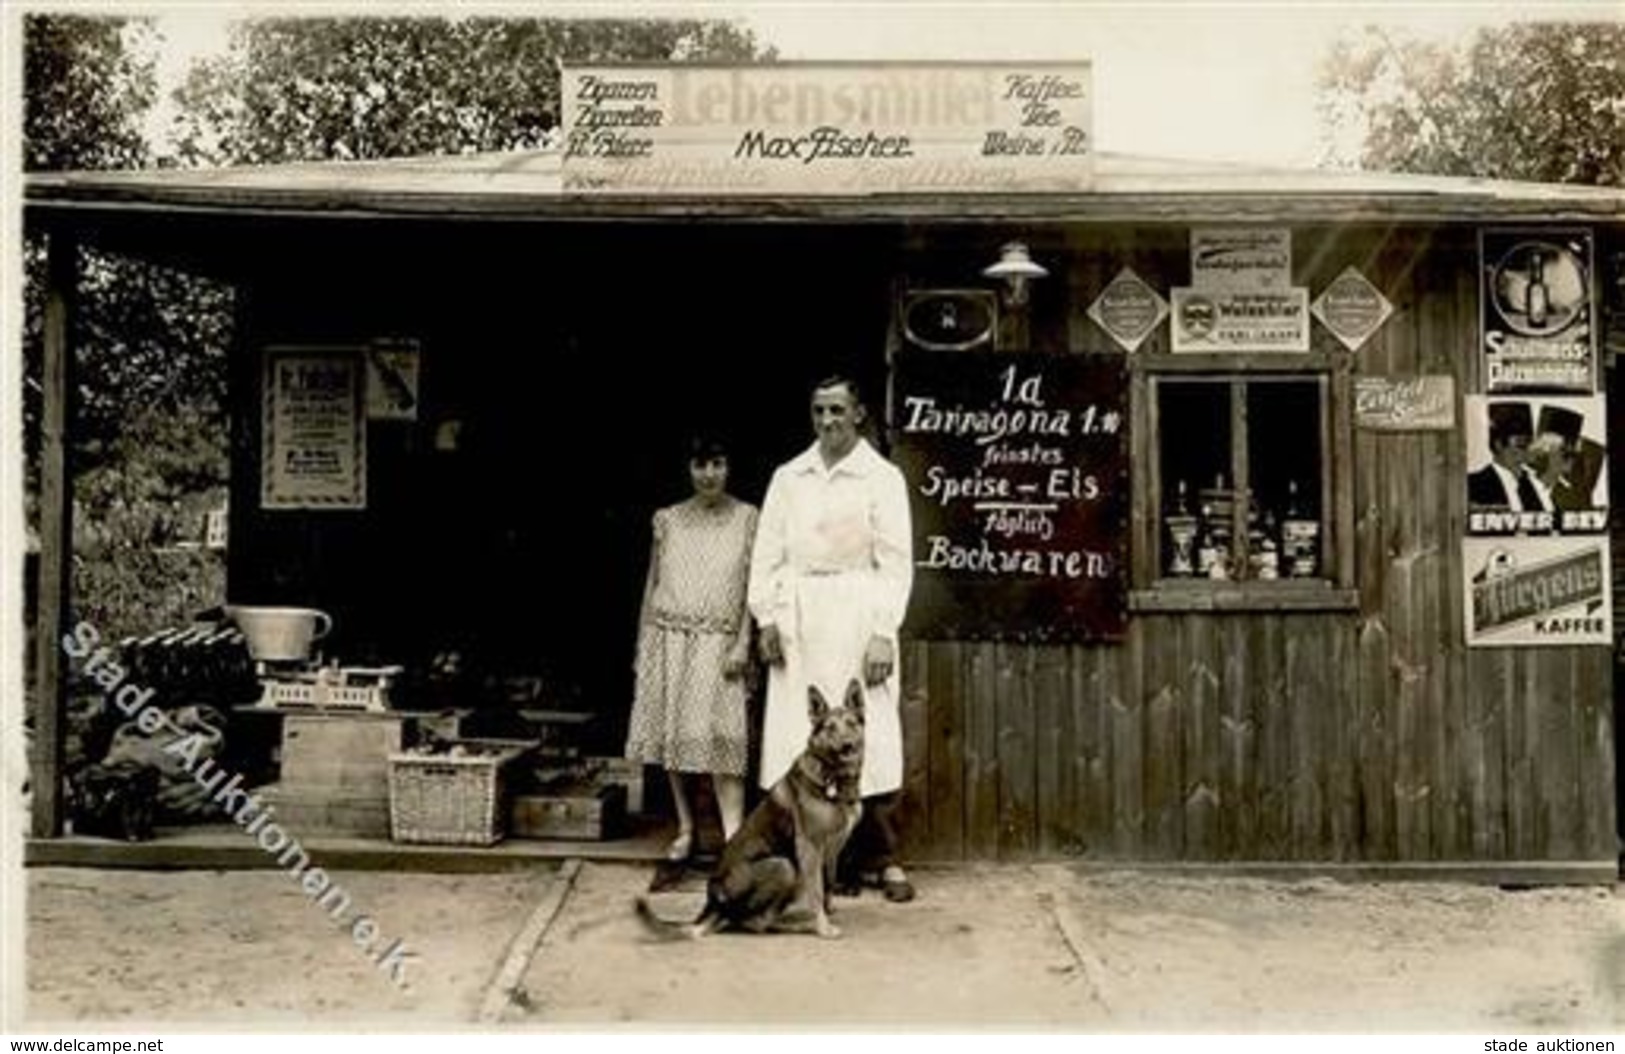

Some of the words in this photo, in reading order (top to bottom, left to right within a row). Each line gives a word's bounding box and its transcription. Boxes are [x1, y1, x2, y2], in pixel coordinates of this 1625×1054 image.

[735, 130, 807, 159] Max
[920, 466, 1010, 505] Speise
[1046, 466, 1099, 499] Eis
[1470, 512, 1553, 532] ENVER
[1562, 511, 1607, 530] BEY
[916, 535, 1108, 578] Backwaren
[1535, 618, 1603, 634] KAFFEE
